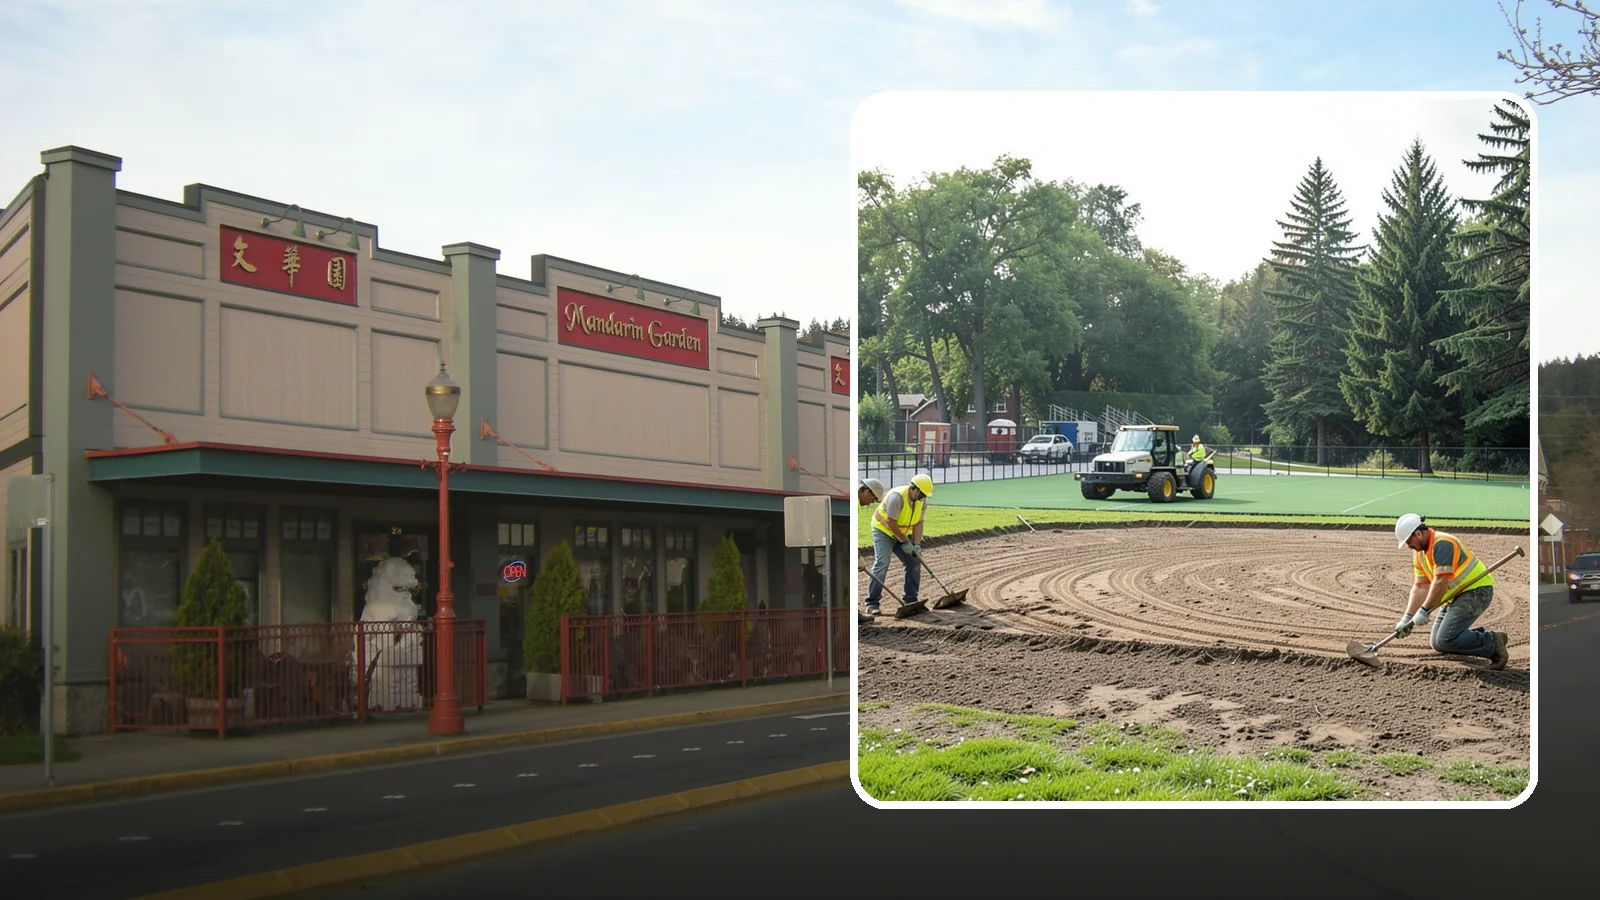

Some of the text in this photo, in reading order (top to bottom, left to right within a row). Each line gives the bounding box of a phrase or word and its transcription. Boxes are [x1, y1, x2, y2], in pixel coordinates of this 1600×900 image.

[231, 235, 347, 291] 文華園
[564, 302, 701, 352] Mandarin Garden
[503, 565, 527, 578] OPEN
